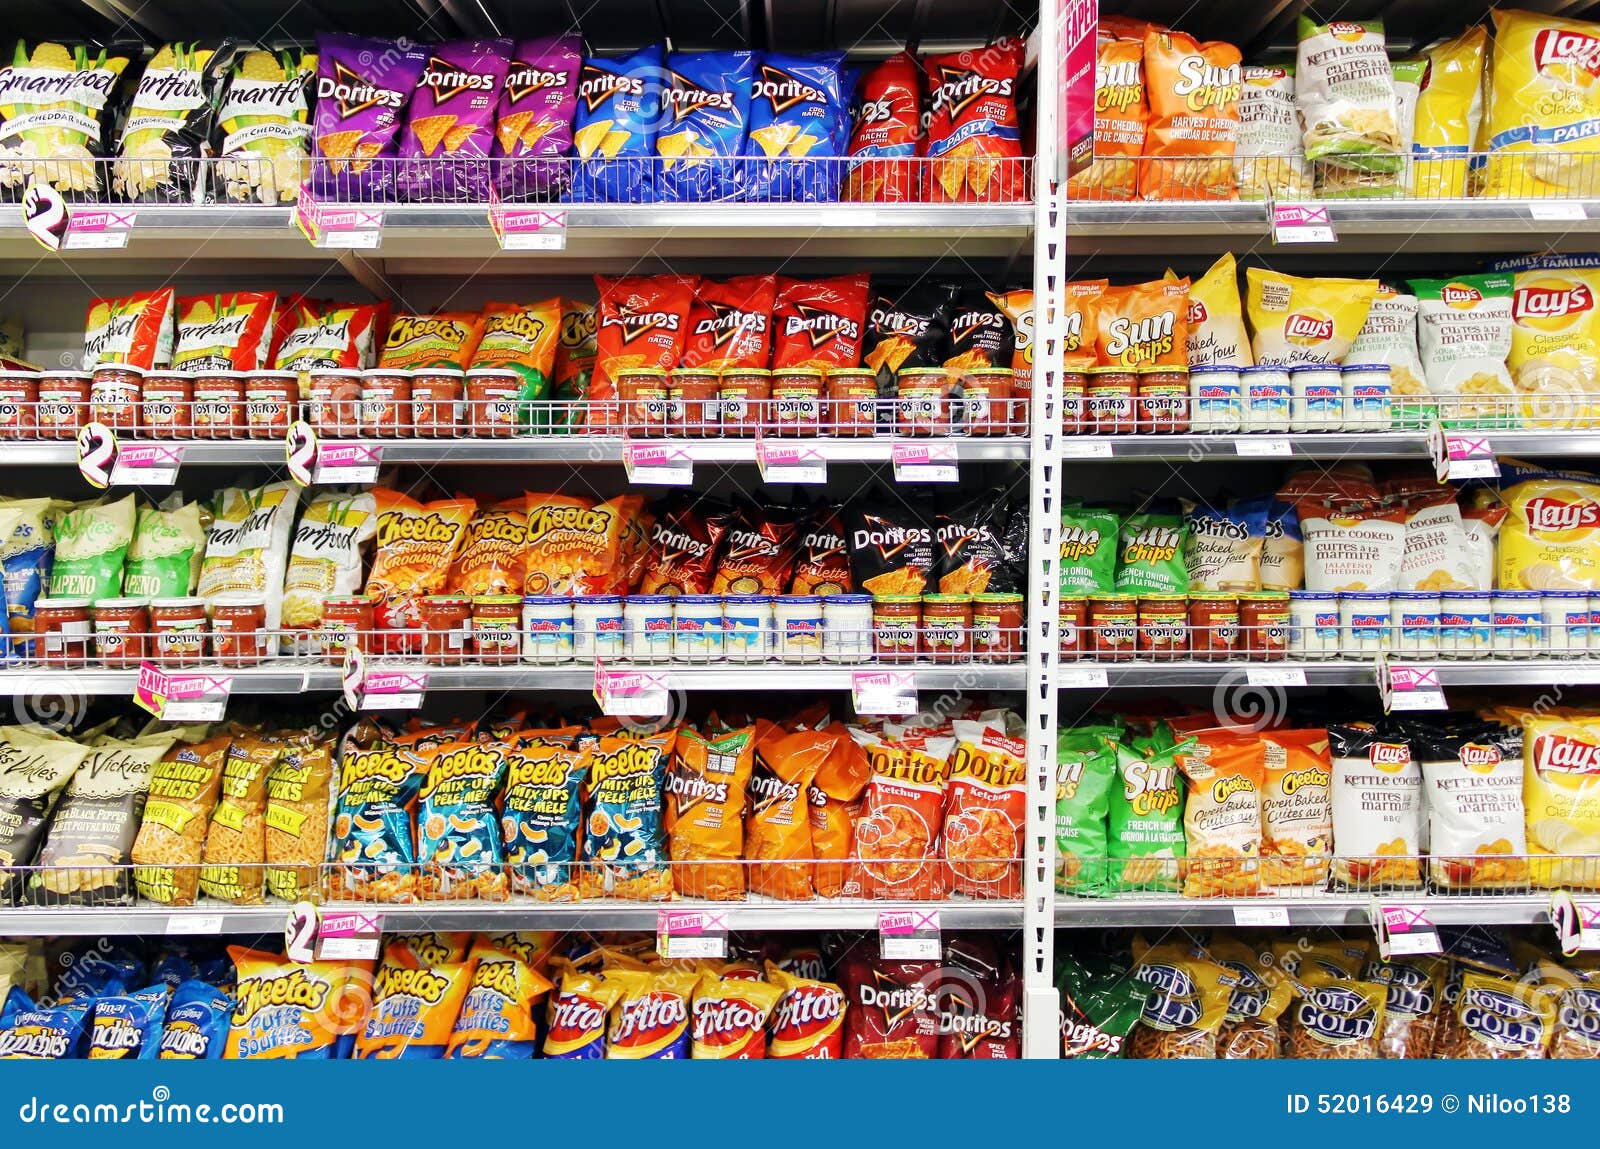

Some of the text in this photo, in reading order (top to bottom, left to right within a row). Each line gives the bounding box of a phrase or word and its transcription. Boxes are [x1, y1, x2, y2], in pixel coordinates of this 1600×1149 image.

[1174, 56, 1241, 95] Sun
[317, 77, 404, 108] Doritos
[1187, 84, 1240, 112] Chips
[976, 106, 1006, 117] NACHO
[1172, 116, 1207, 128] HARVEST
[1514, 285, 1588, 317] Lay's
[696, 311, 766, 335] Doritos
[1107, 311, 1174, 356] Sun
[1286, 315, 1333, 341] Lay's
[1120, 337, 1173, 367] Chips
[1534, 333, 1580, 344] Classic
[528, 506, 610, 543] Cheetos
[1529, 498, 1599, 533] Lay's
[377, 511, 459, 549] Cheetos
[855, 525, 931, 550] Doritos
[1197, 540, 1233, 555] Baked
[140, 669, 168, 696] SAVE
[90, 749, 151, 780] Vickie's
[1373, 745, 1408, 764] Lay's
[878, 785, 921, 801] Ketchup
[970, 786, 1010, 802] Ketchup
[1213, 777, 1254, 804] Cheetos
[1283, 769, 1328, 795] Cheetos
[70, 808, 128, 824] BLACK PEPPER
[1133, 789, 1179, 816] Chips
[1263, 799, 1295, 812] Oven
[1128, 820, 1159, 831] FRENCH
[860, 985, 937, 1011] Doritos
[693, 998, 766, 1040] Fritos
[940, 1011, 1011, 1038] Doritos
[1297, 1004, 1374, 1038] GOLD
[1461, 1007, 1540, 1045] GOLD
